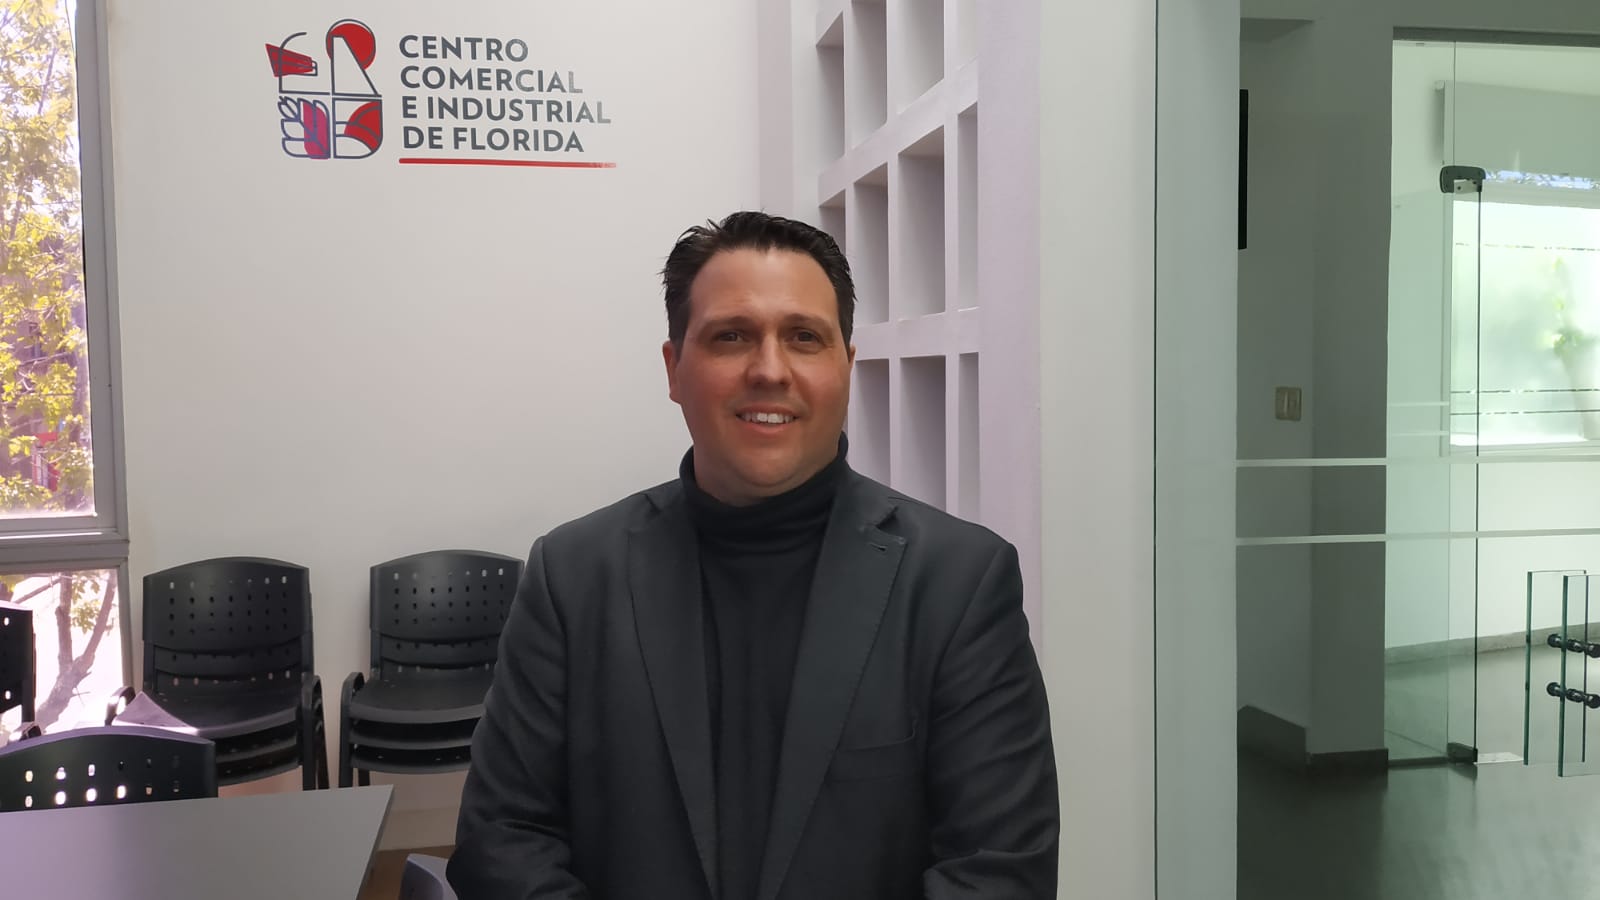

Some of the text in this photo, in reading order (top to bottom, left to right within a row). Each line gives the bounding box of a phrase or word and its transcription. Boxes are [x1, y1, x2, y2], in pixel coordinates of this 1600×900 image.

[399, 35, 529, 62] CENTRO
[400, 65, 583, 94] COMERCIAL
[402, 96, 612, 124] E INDUSTRIAL
[403, 126, 585, 153] DE FLORIDA
